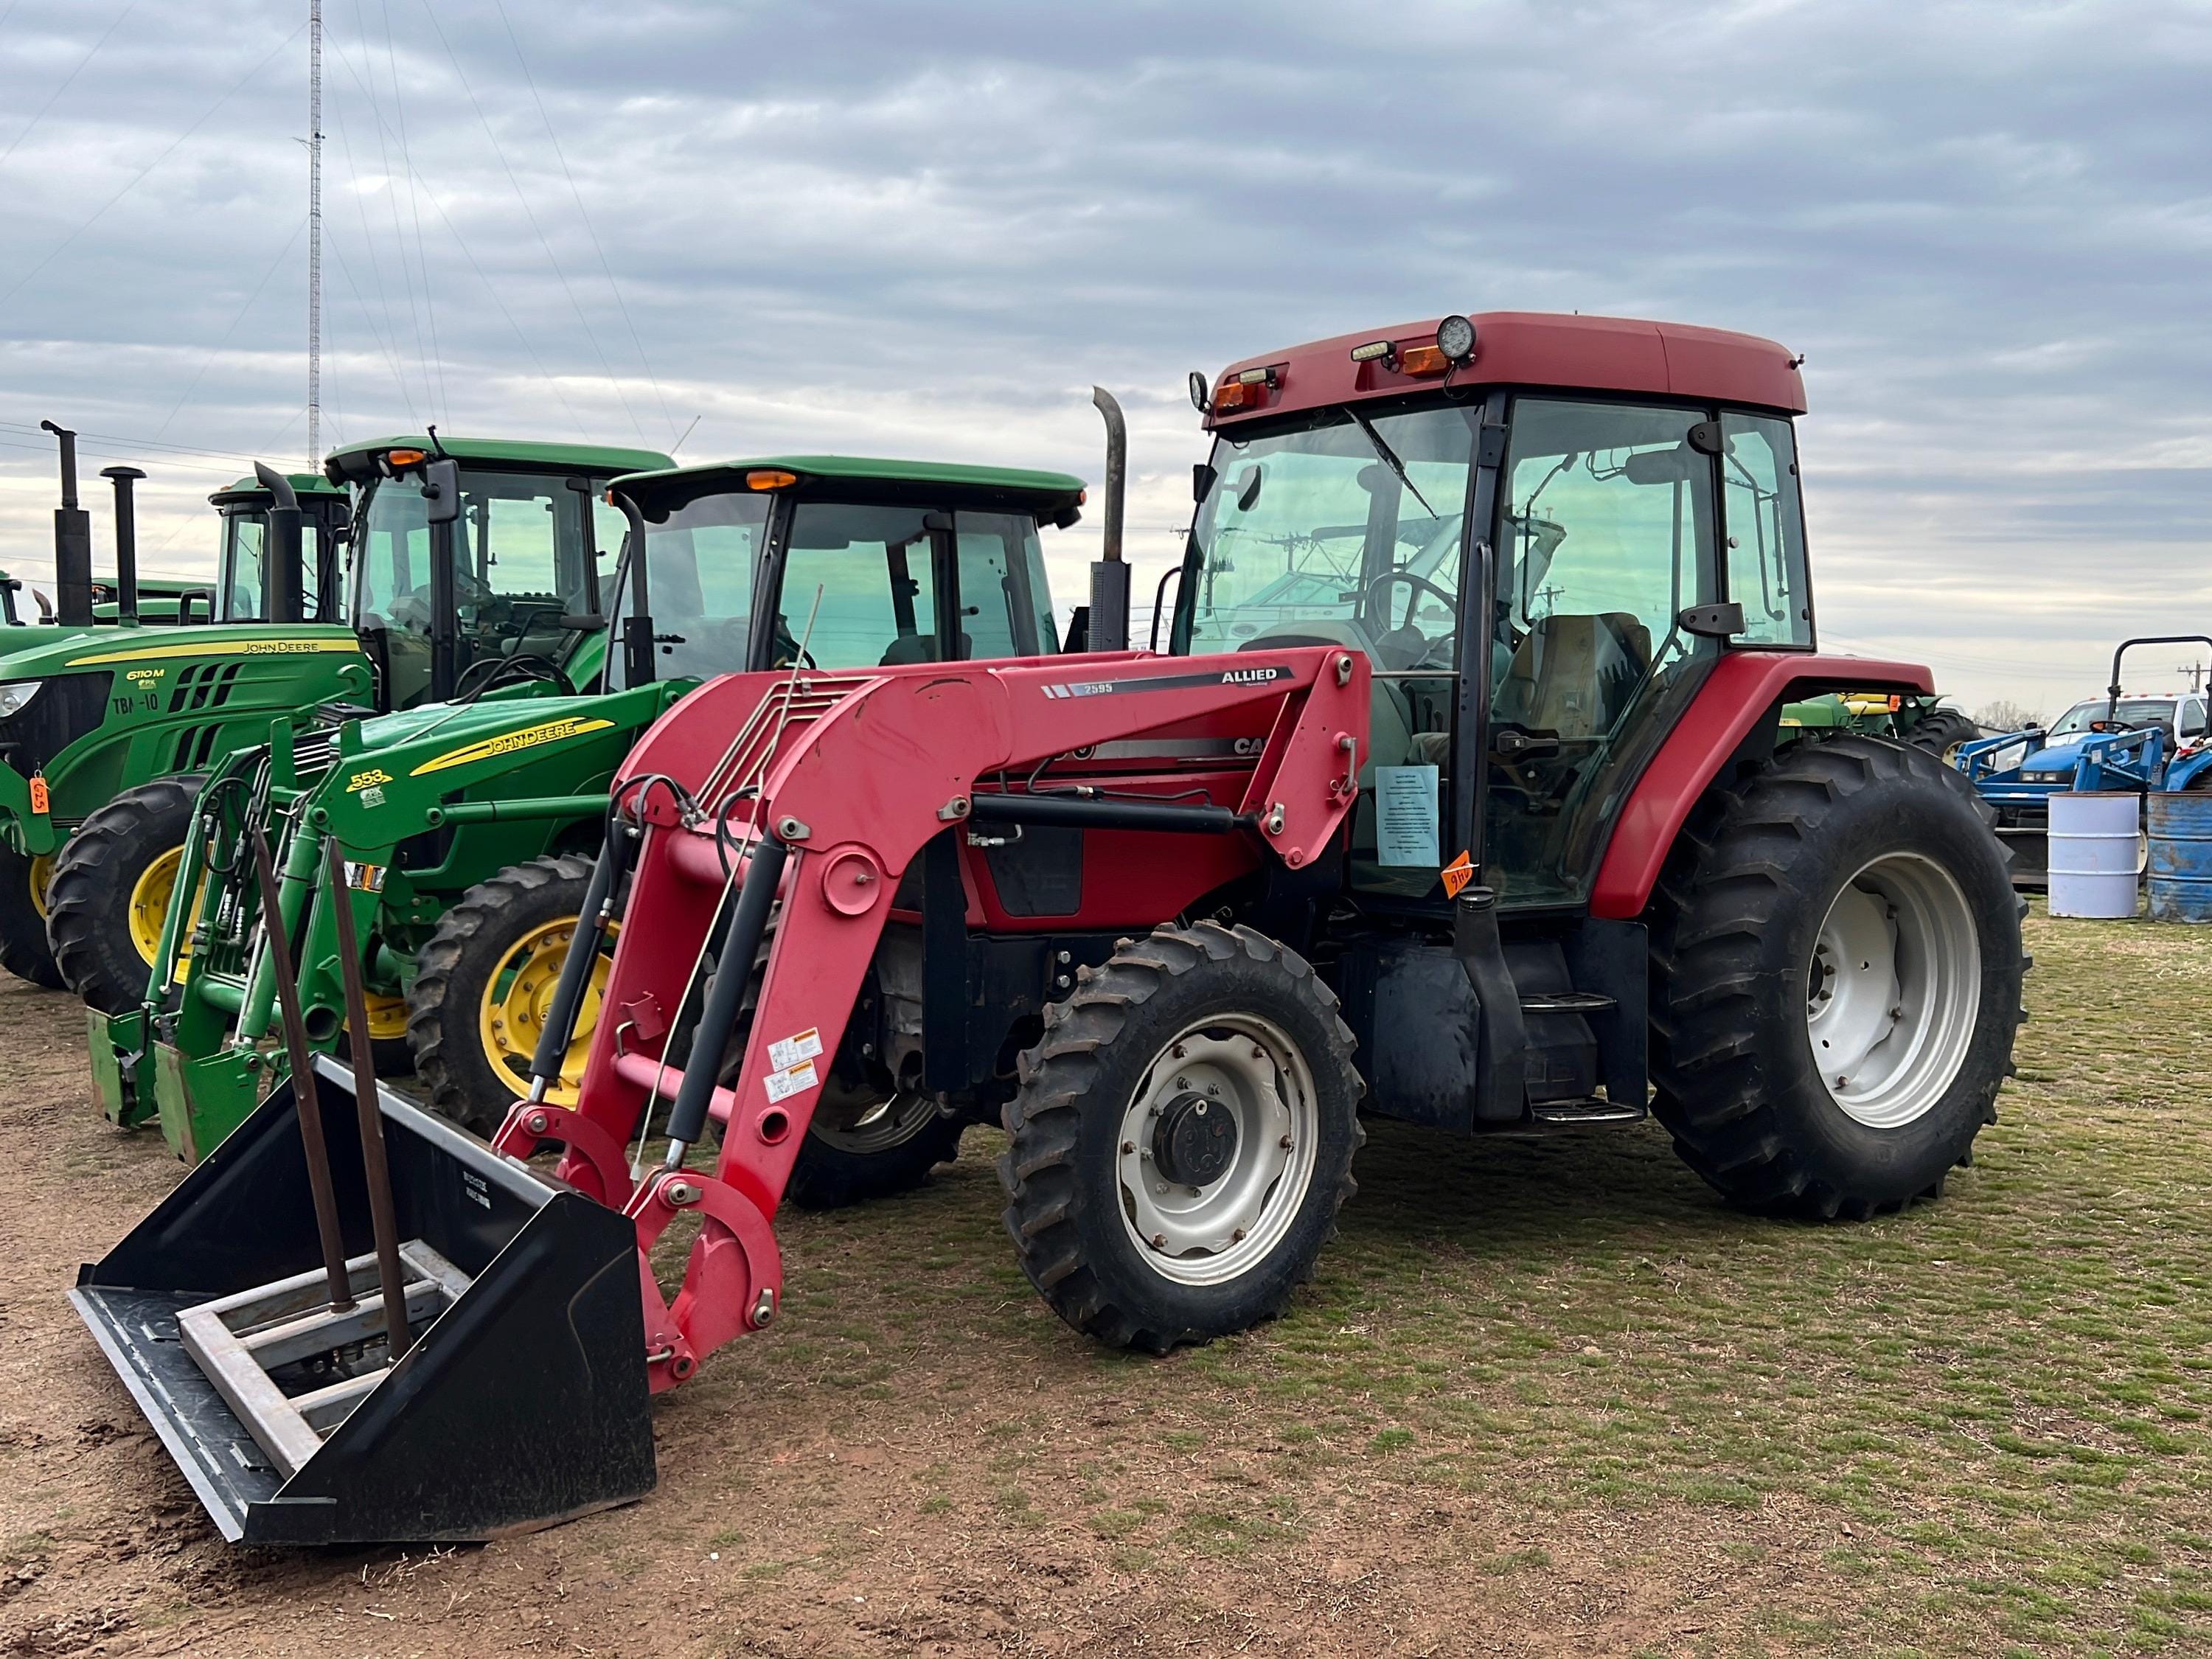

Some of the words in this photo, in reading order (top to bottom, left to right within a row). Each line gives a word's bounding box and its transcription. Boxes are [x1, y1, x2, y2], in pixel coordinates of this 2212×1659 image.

[1222, 669, 1277, 684] ALLIED
[1085, 684, 1113, 694] 2595
[1234, 737, 1268, 755] CA
[350, 769, 383, 787] 553
